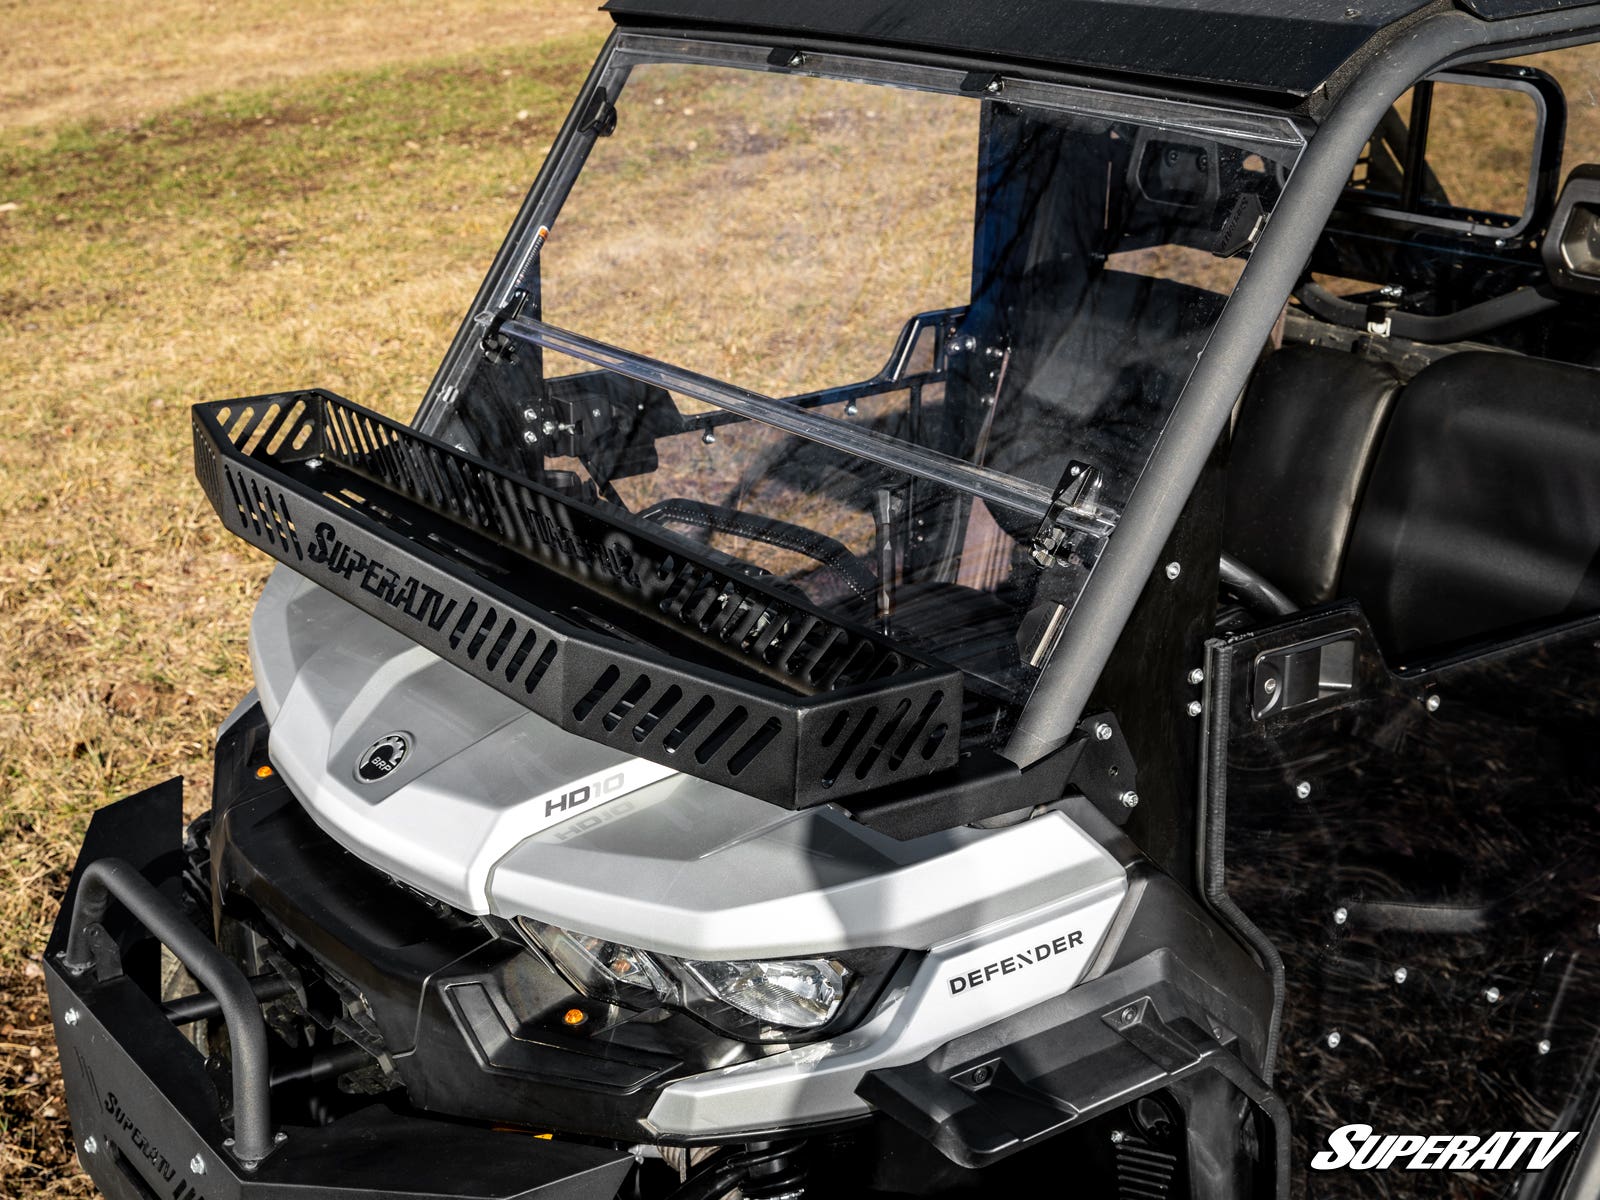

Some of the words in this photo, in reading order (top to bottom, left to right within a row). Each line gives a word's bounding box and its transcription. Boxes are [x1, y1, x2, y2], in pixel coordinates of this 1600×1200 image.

[371, 756, 392, 771] BRP
[545, 773, 624, 818] HD10
[949, 930, 1084, 995] DEFENDER
